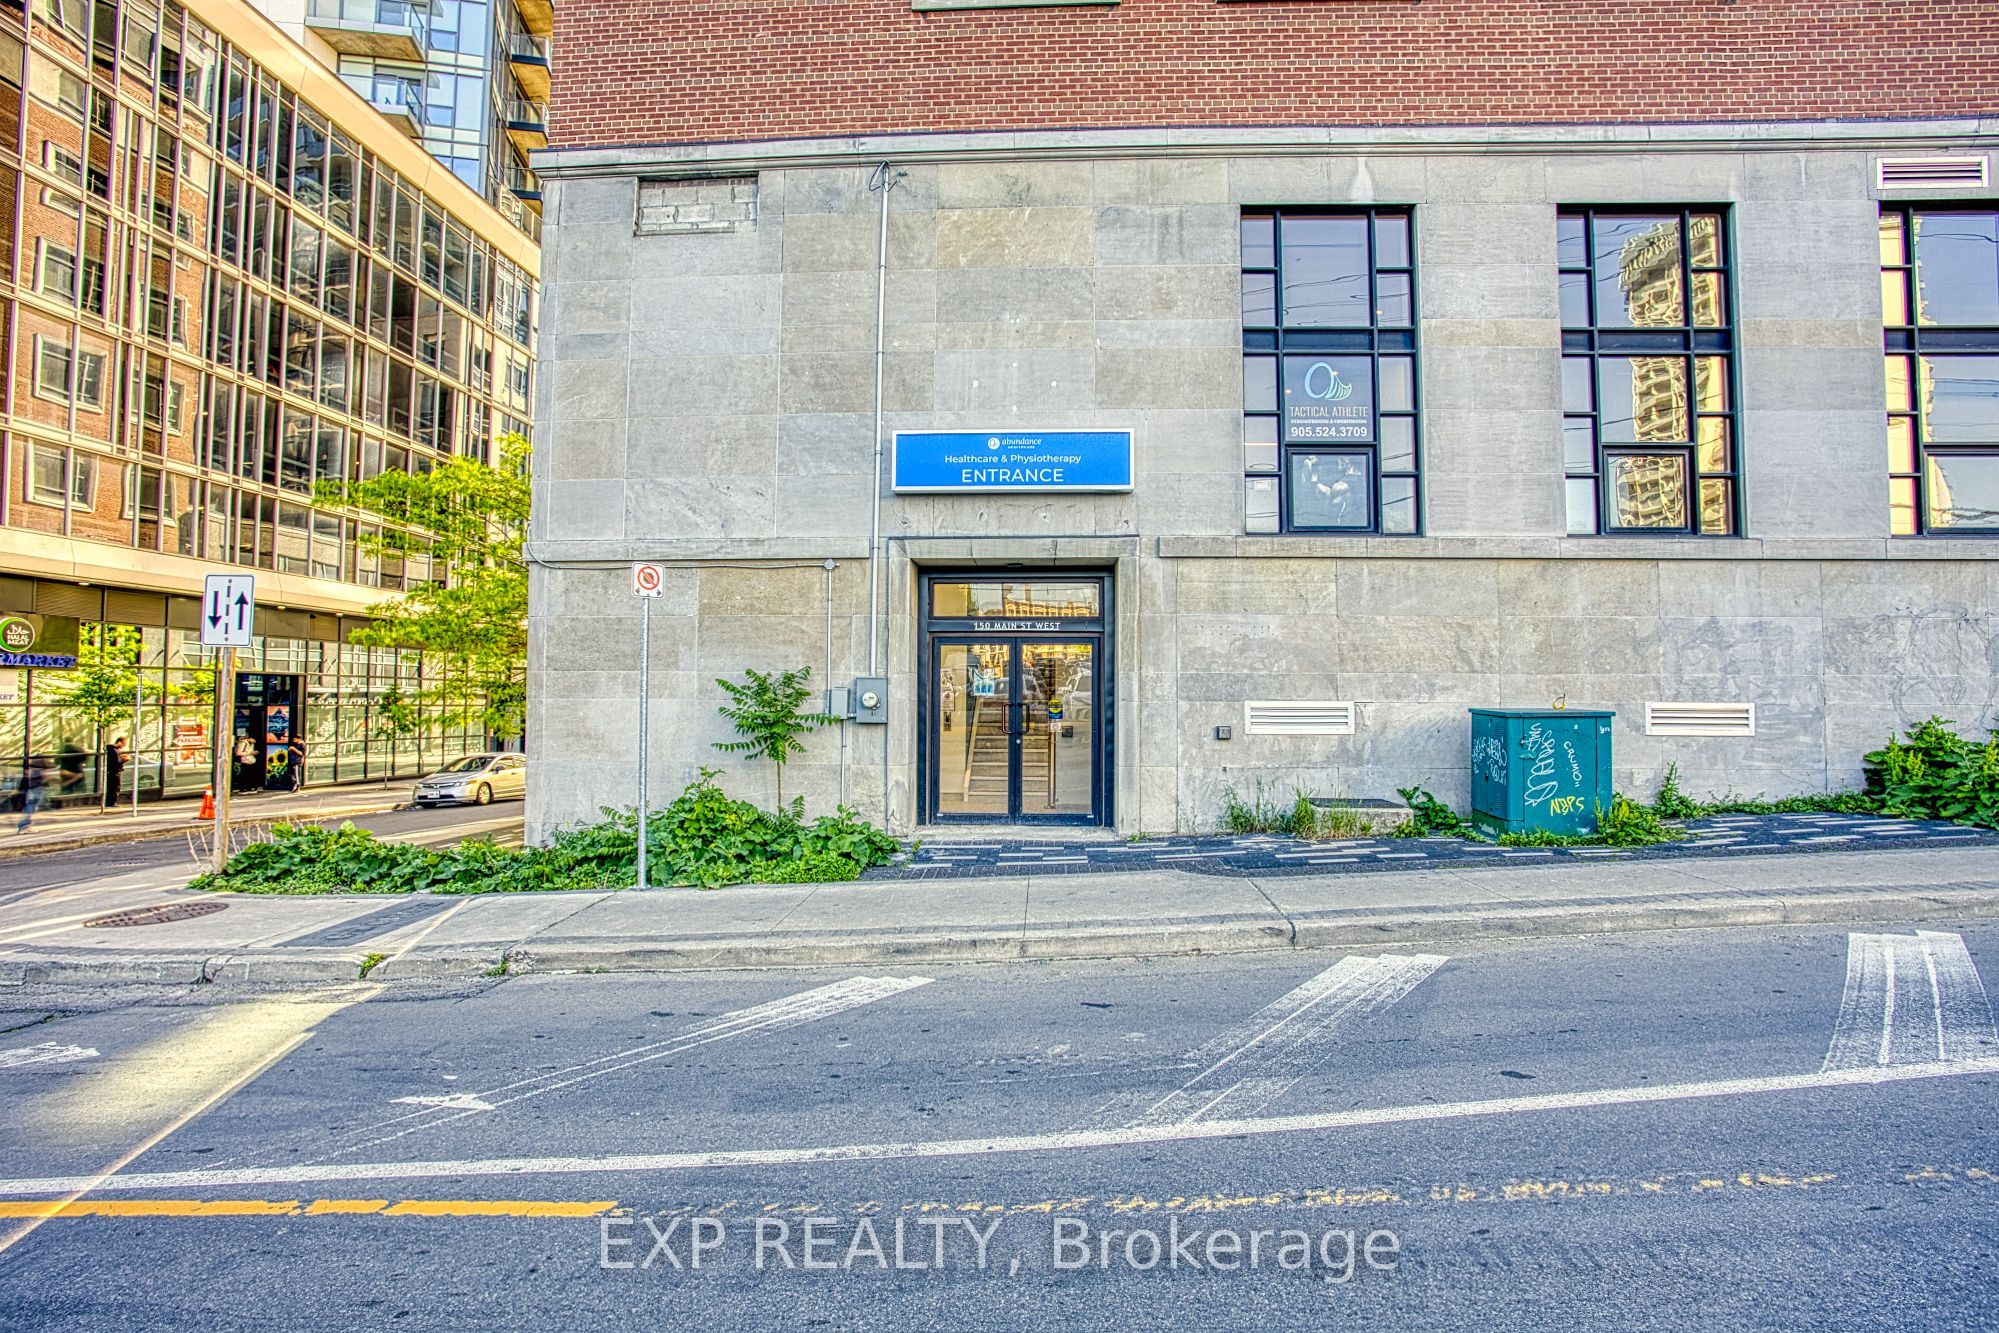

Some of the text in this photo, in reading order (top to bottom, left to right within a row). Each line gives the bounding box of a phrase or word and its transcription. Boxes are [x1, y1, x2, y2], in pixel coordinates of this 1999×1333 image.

[1289, 406, 1369, 417] TACTICAL ATHLETE
[1291, 426, 1368, 437] 905.524.3709
[1001, 437, 1042, 445] abundance
[945, 453, 1082, 465] Healthcare & Physiotherapy
[962, 468, 1064, 483] ENTRANCE
[973, 621, 1062, 631] 150 MAIN ST WEST
